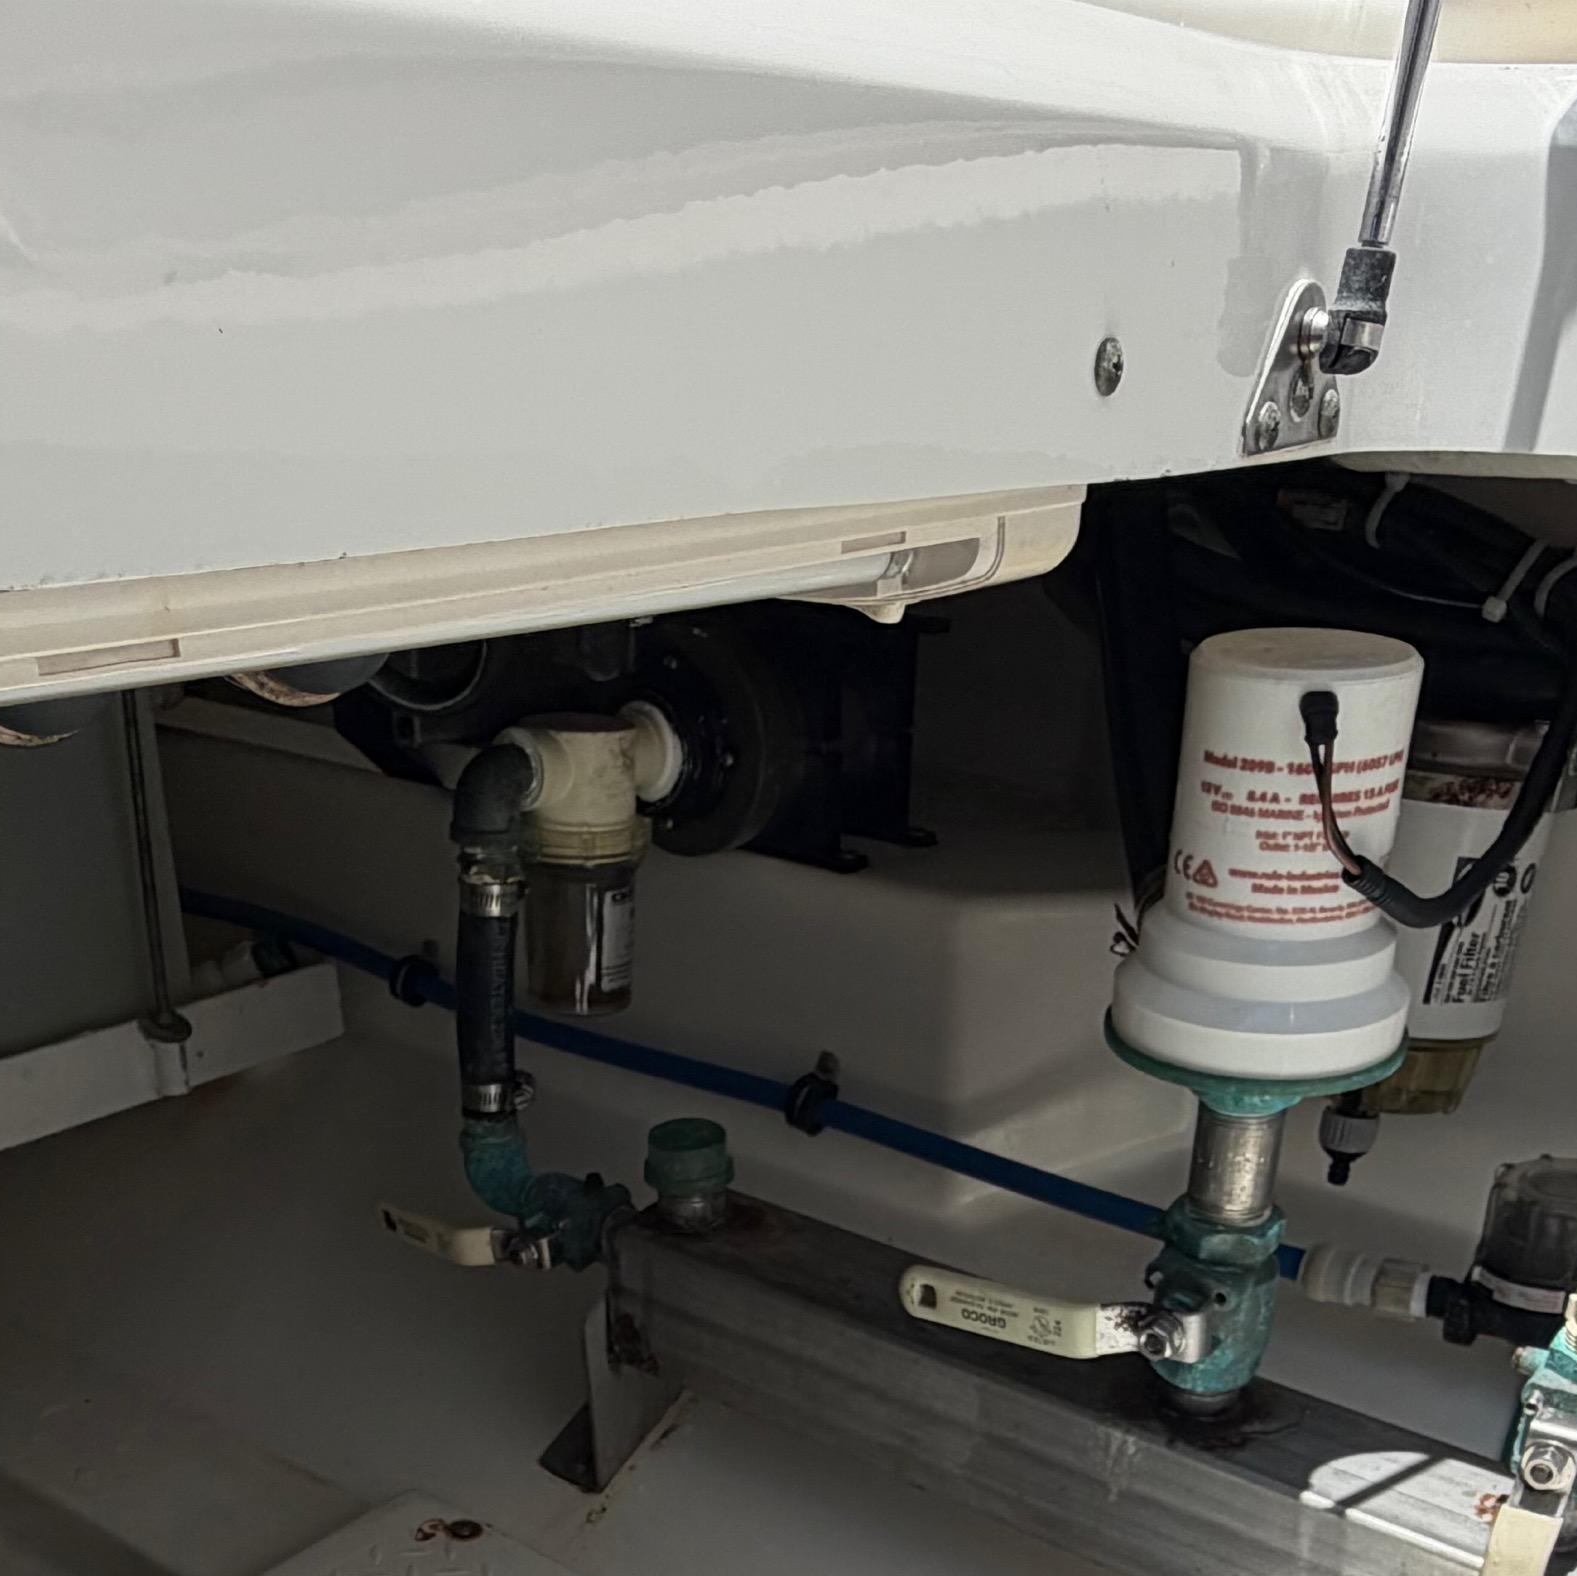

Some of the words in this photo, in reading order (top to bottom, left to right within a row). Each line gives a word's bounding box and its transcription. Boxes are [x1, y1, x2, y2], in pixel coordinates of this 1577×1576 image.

[1204, 750, 1237, 768] Model
[1287, 762, 1316, 775] 160
[1460, 932, 1481, 969] Filter
[1452, 972, 1469, 1003] Fuel
[961, 1308, 1006, 1329] GROCO
